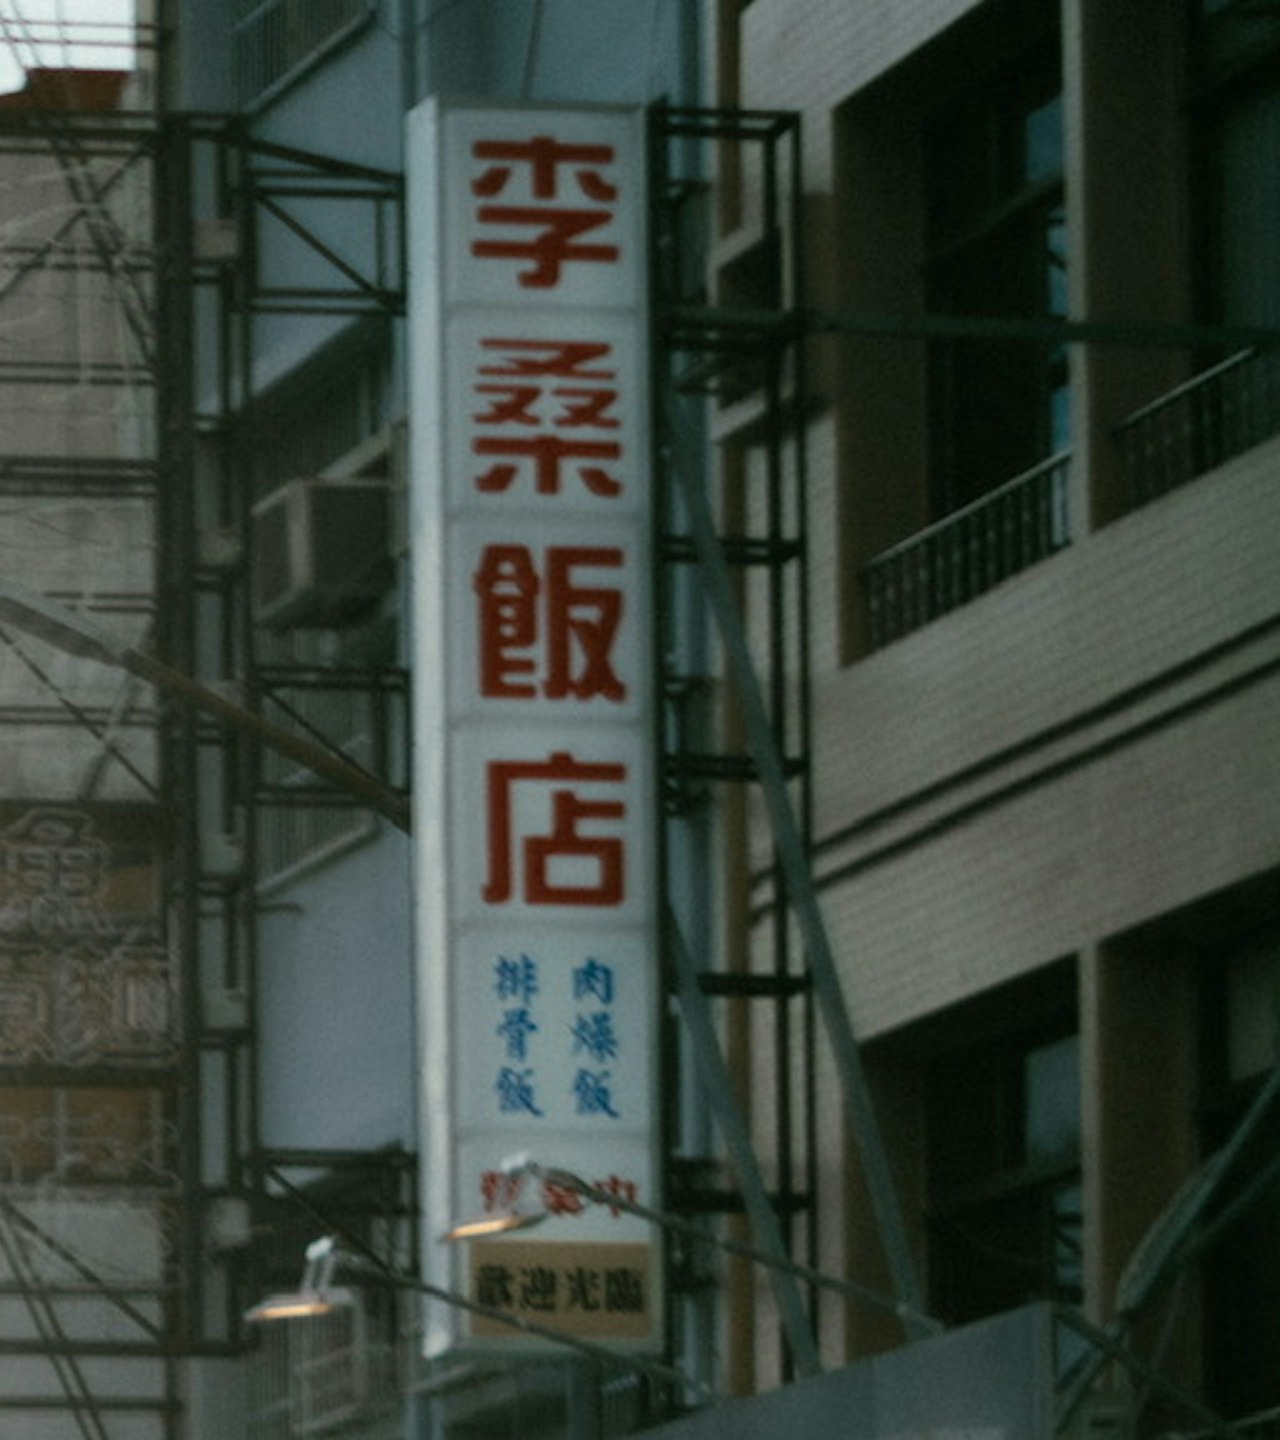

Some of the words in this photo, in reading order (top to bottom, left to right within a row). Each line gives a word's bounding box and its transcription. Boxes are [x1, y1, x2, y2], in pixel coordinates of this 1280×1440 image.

[469, 134, 628, 908] 李桑飯店
[491, 952, 543, 1119] 排骨飯
[570, 955, 621, 1120] 肉燥飯
